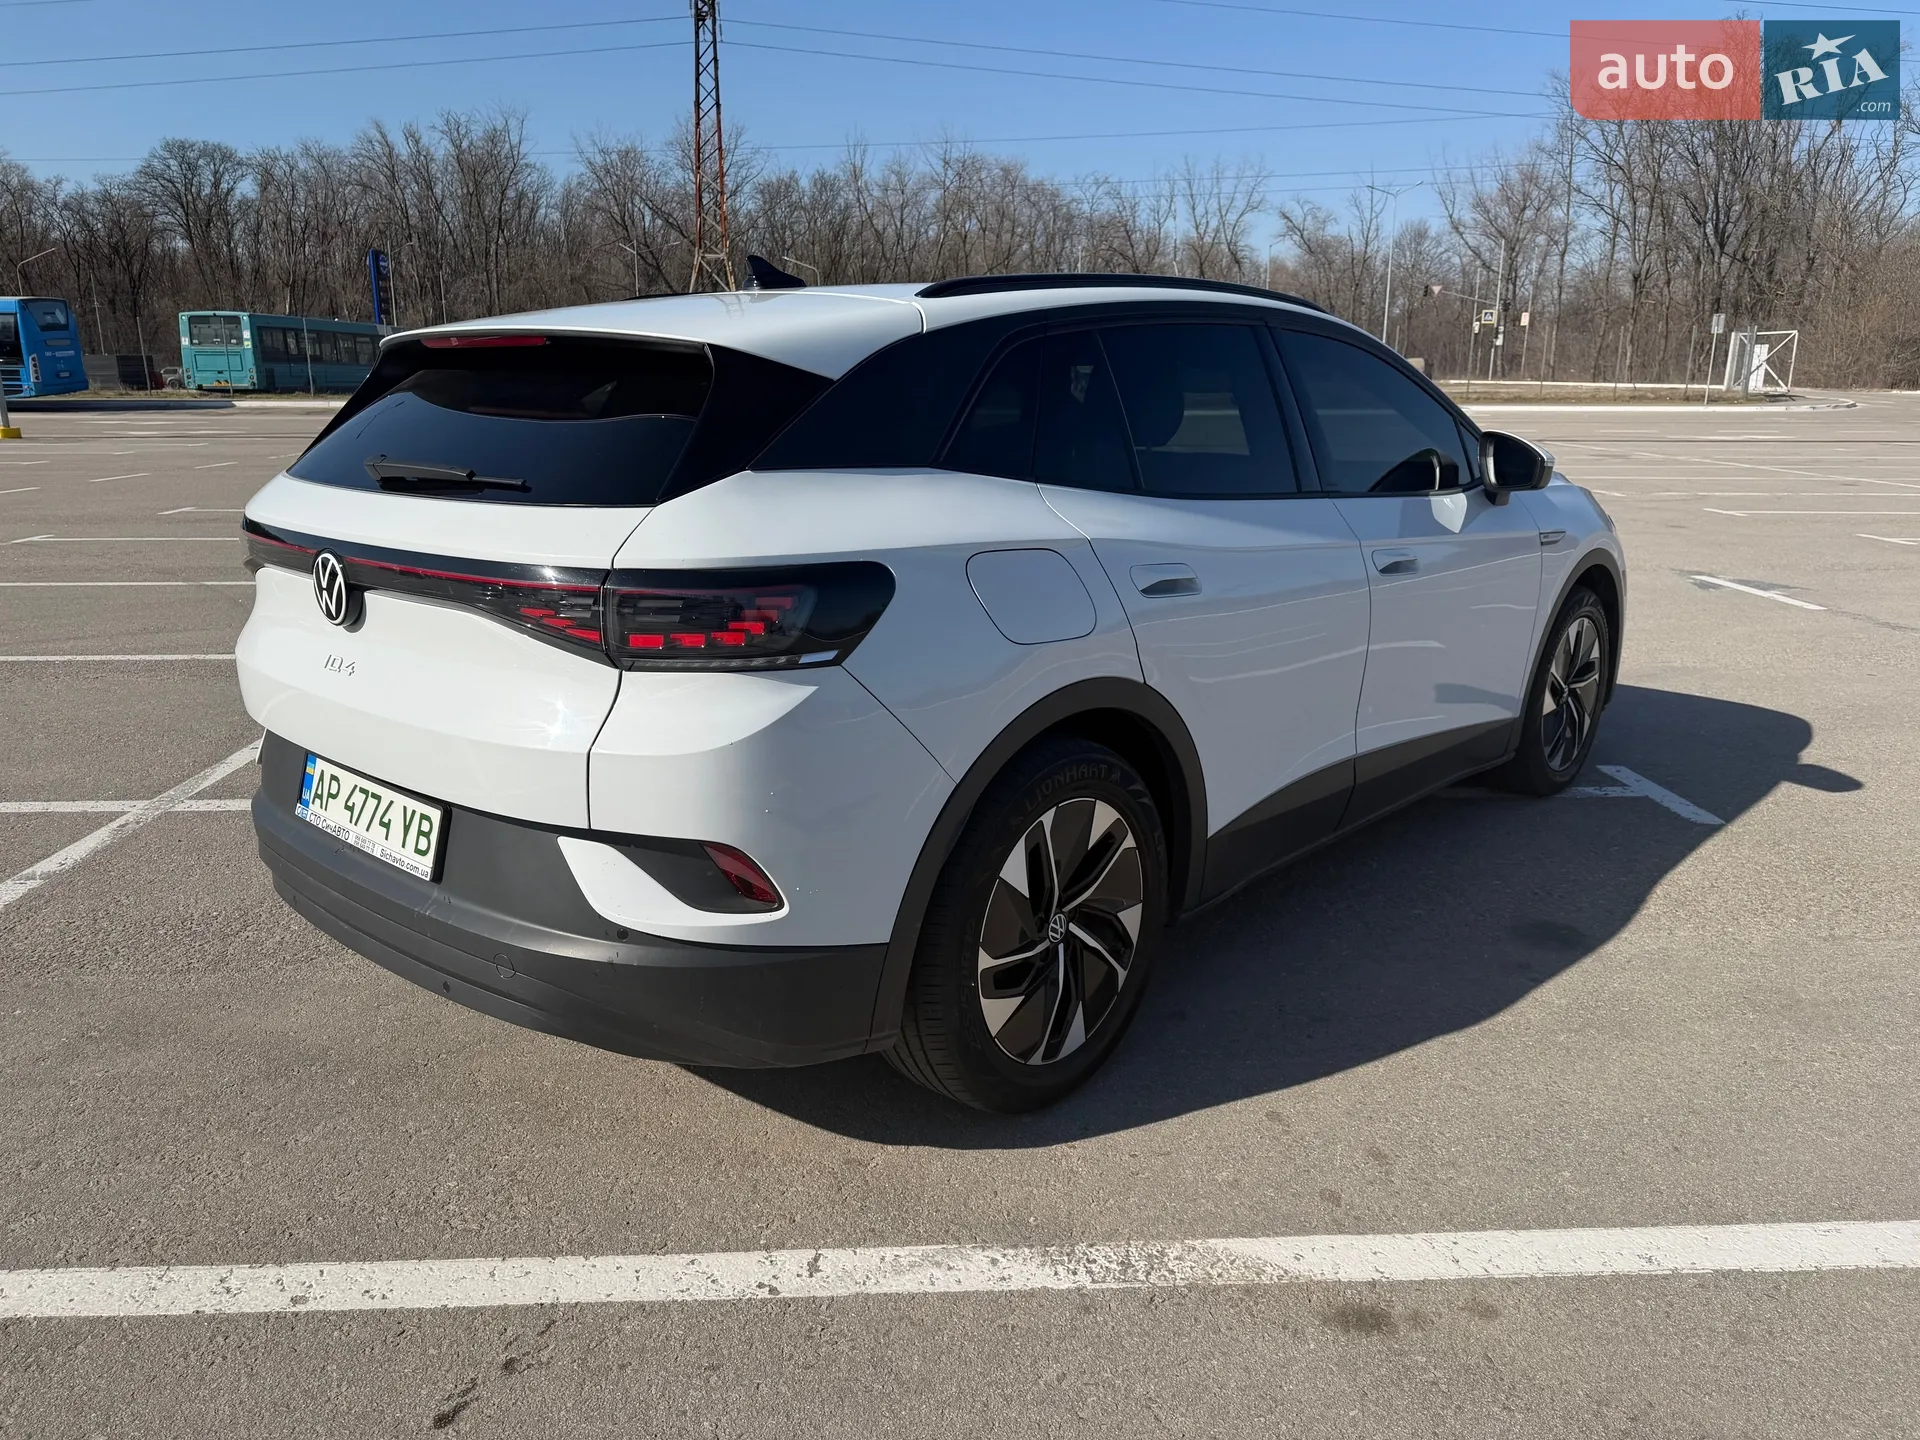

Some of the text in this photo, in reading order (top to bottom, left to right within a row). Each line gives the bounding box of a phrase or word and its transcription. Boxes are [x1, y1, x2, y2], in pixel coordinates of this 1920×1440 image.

[311, 769, 341, 812] AP
[343, 784, 395, 841] 4774
[402, 805, 434, 857] YB
